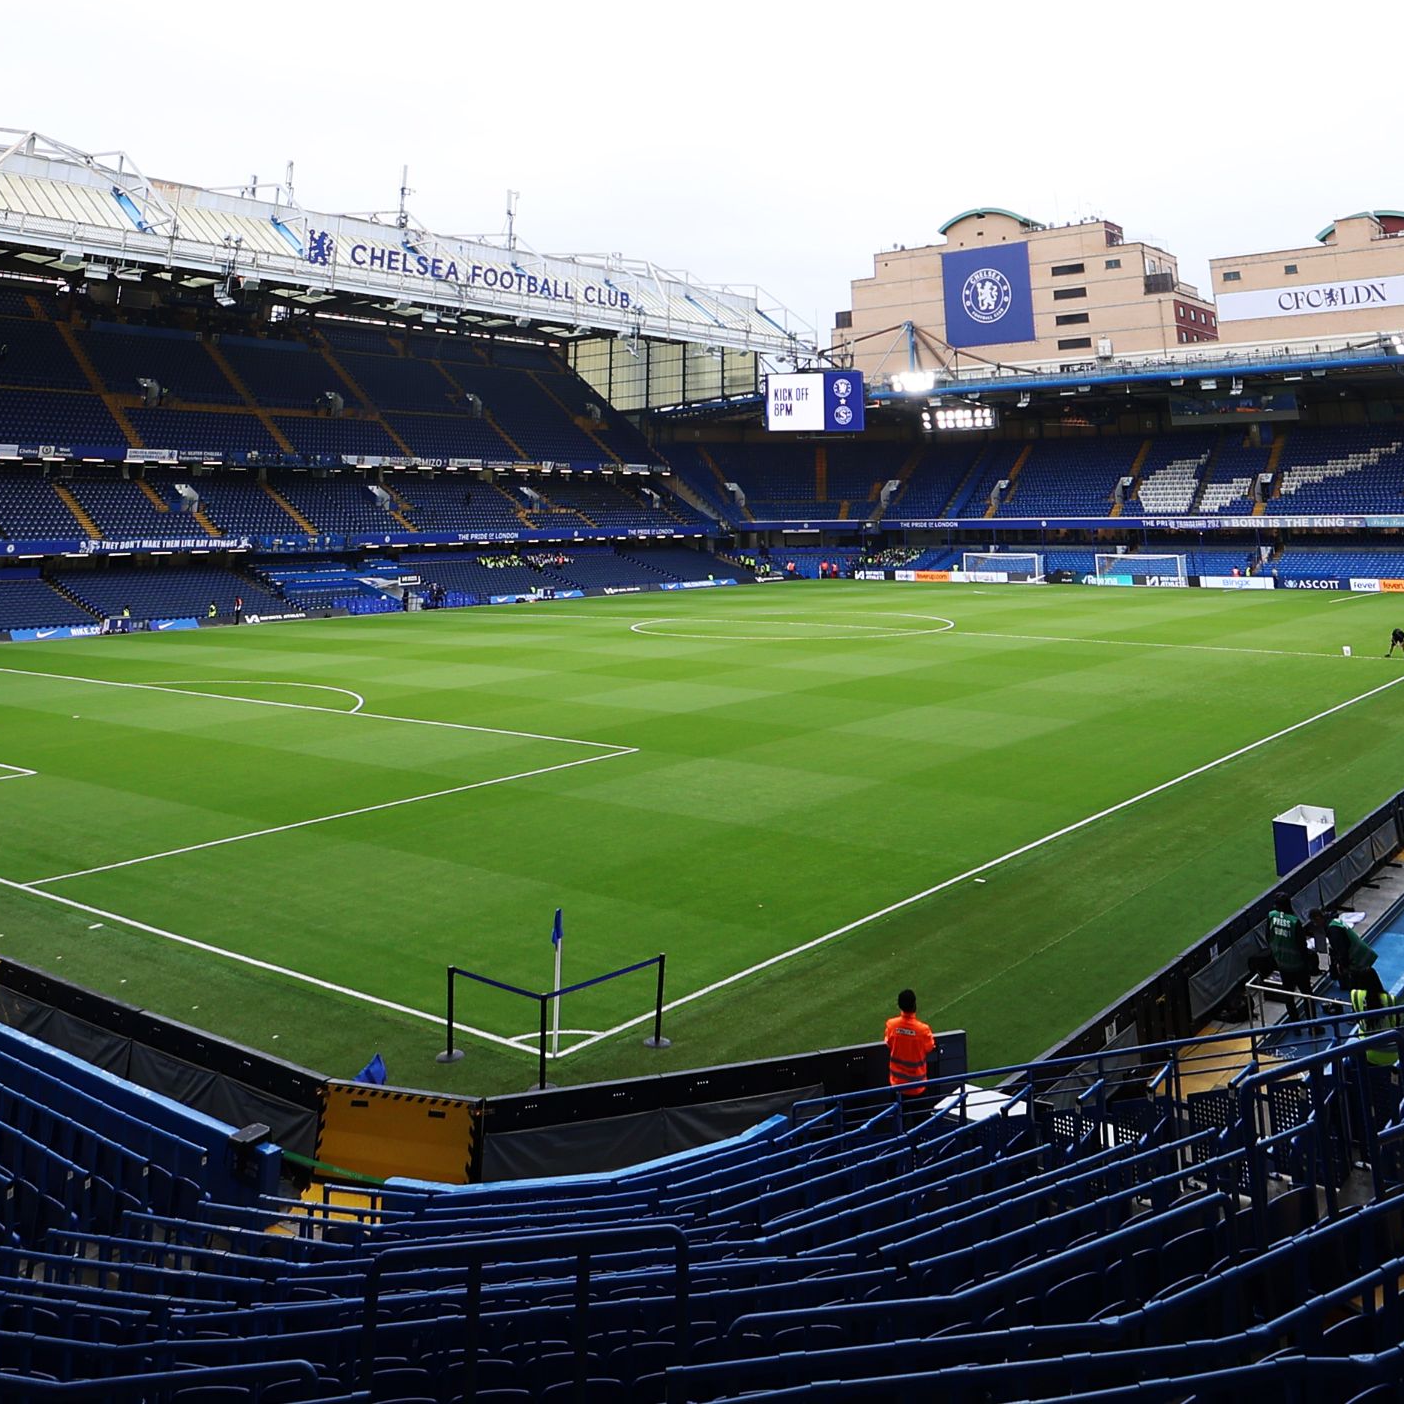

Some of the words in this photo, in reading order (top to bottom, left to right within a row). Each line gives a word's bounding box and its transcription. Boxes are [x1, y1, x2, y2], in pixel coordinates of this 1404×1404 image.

[351, 244, 459, 281] CHELSEA
[471, 265, 574, 300] FOOTBALL
[584, 286, 630, 308] CLUB
[970, 271, 1001, 284] CHELSEA
[1278, 289, 1324, 311] CFC
[1340, 283, 1387, 305] LDN
[774, 388, 793, 401] KICK
[796, 388, 809, 401] OFF
[774, 403, 793, 416] 8PM
[1231, 518, 1266, 527] BORN
[1269, 518, 1280, 527] IS
[1285, 518, 1310, 527] THE
[1314, 517, 1346, 527] KING
[102, 541, 119, 549] THEY
[119, 540, 141, 549] DON'T
[142, 540, 161, 548] MAKE
[162, 540, 180, 548] THEM
[196, 539, 208, 547] RAY
[209, 539, 238, 547] ANYMORE
[1298, 580, 1340, 589] ASCOTT
[1353, 581, 1376, 589] fever
[1273, 917, 1292, 928] PRESS
